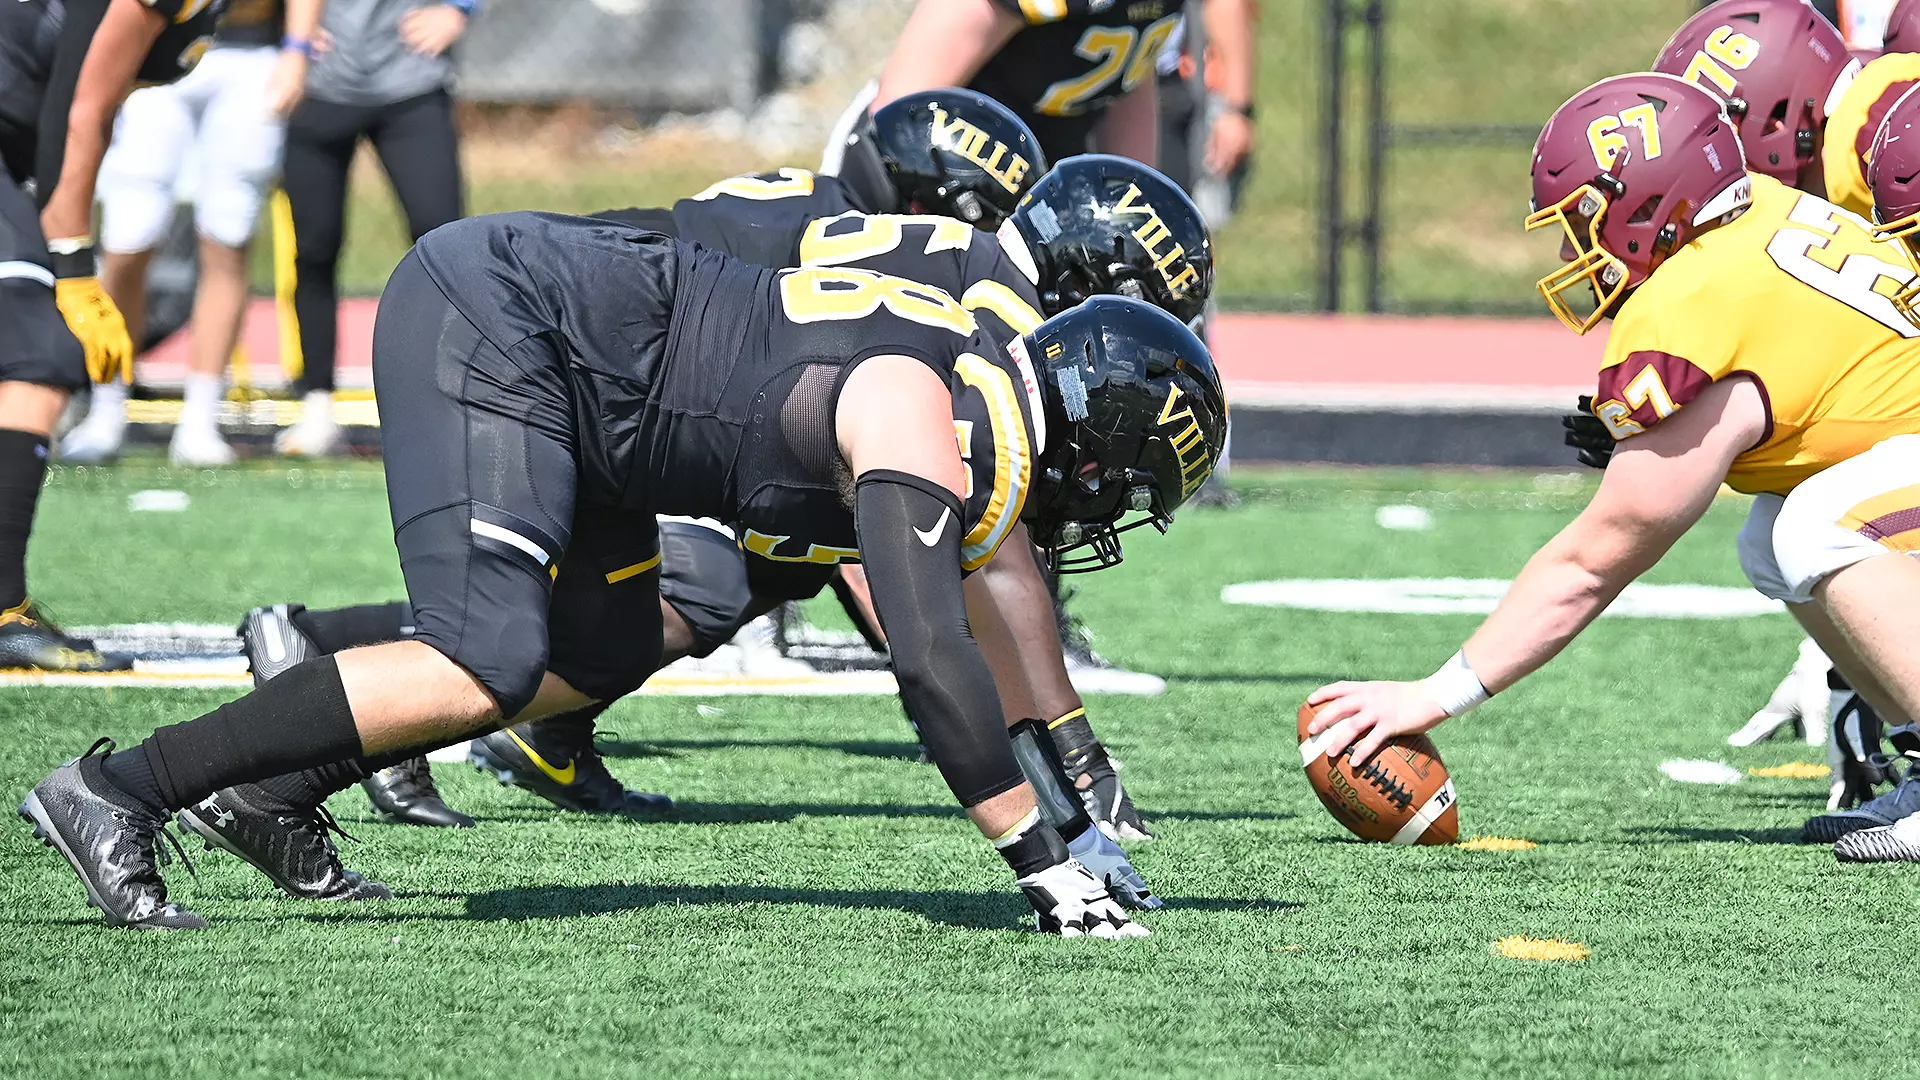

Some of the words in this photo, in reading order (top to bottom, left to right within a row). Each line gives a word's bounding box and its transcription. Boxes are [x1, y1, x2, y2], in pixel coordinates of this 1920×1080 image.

[1682, 25, 1760, 97] 76
[931, 109, 1030, 195] VILLE
[1586, 102, 1663, 173] 67
[1111, 183, 1200, 300] VILLE
[1596, 363, 1683, 440] 67
[1327, 767, 1380, 824] Wilson
